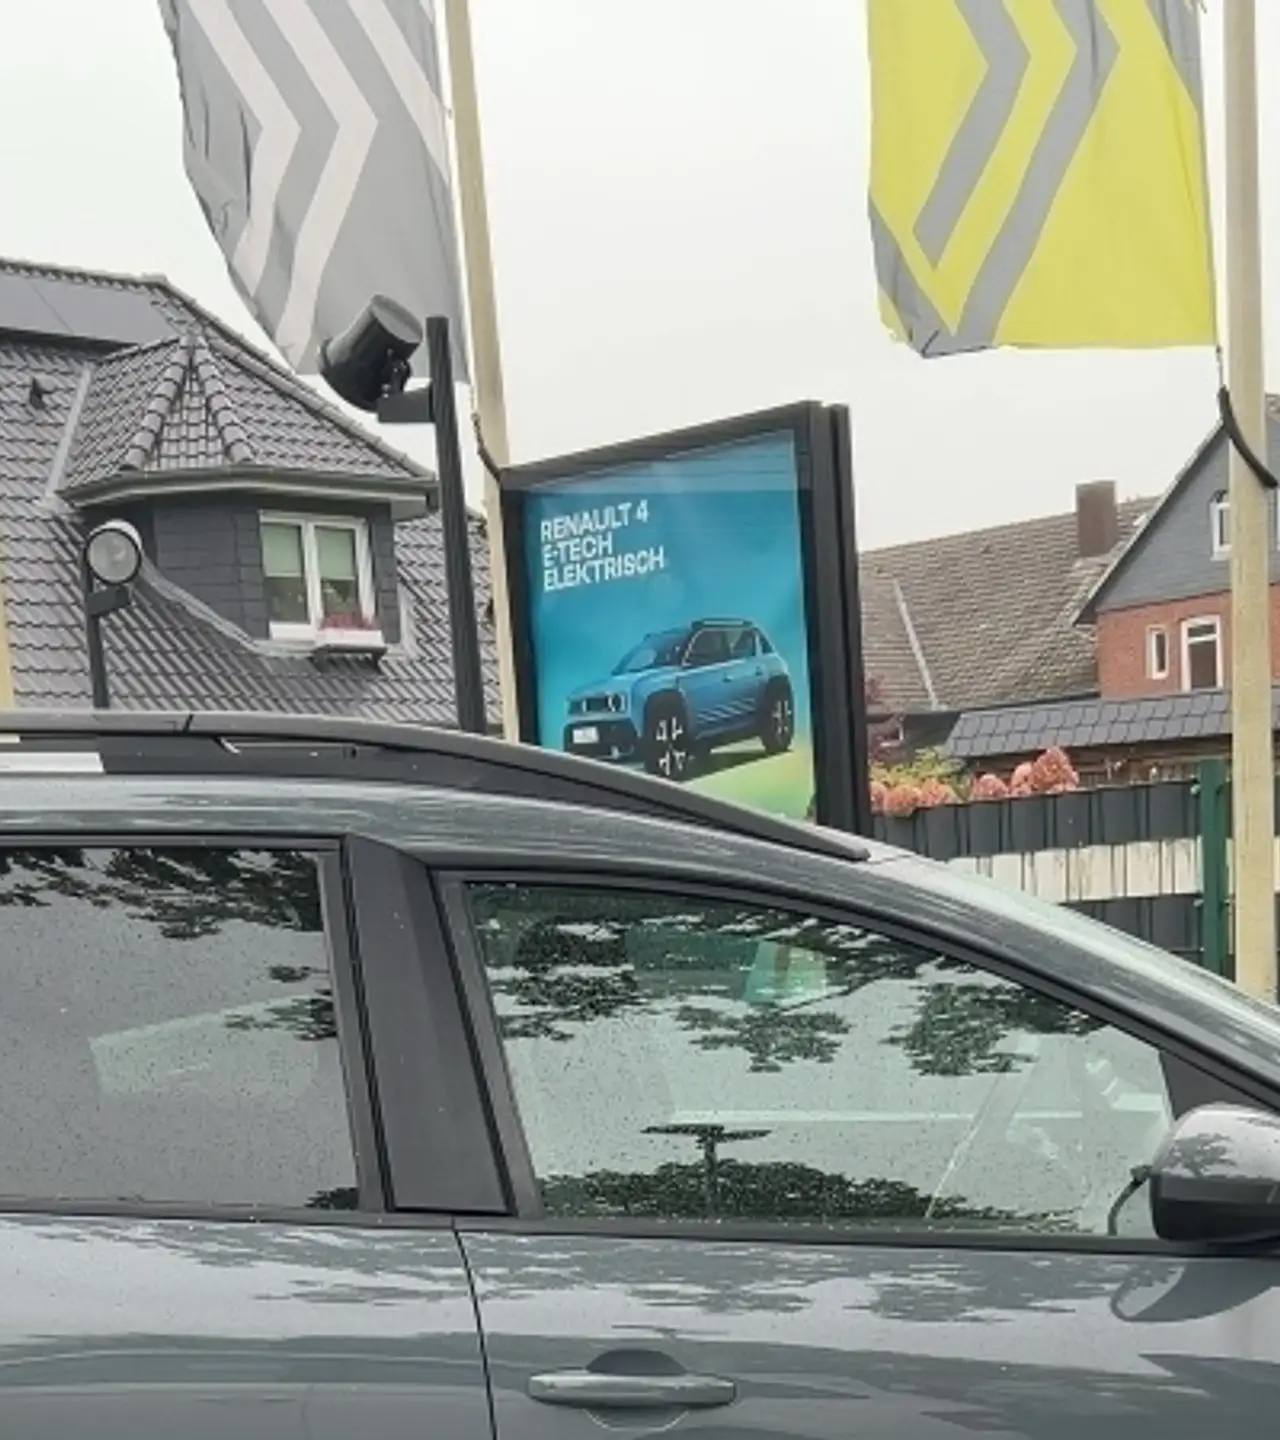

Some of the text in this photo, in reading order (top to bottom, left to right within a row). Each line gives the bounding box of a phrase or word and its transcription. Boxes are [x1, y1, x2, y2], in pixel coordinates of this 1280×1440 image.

[541, 500, 649, 540] RENAULT 4
[543, 533, 612, 567] E-TECH
[543, 546, 664, 592] ELEKTRISCH
